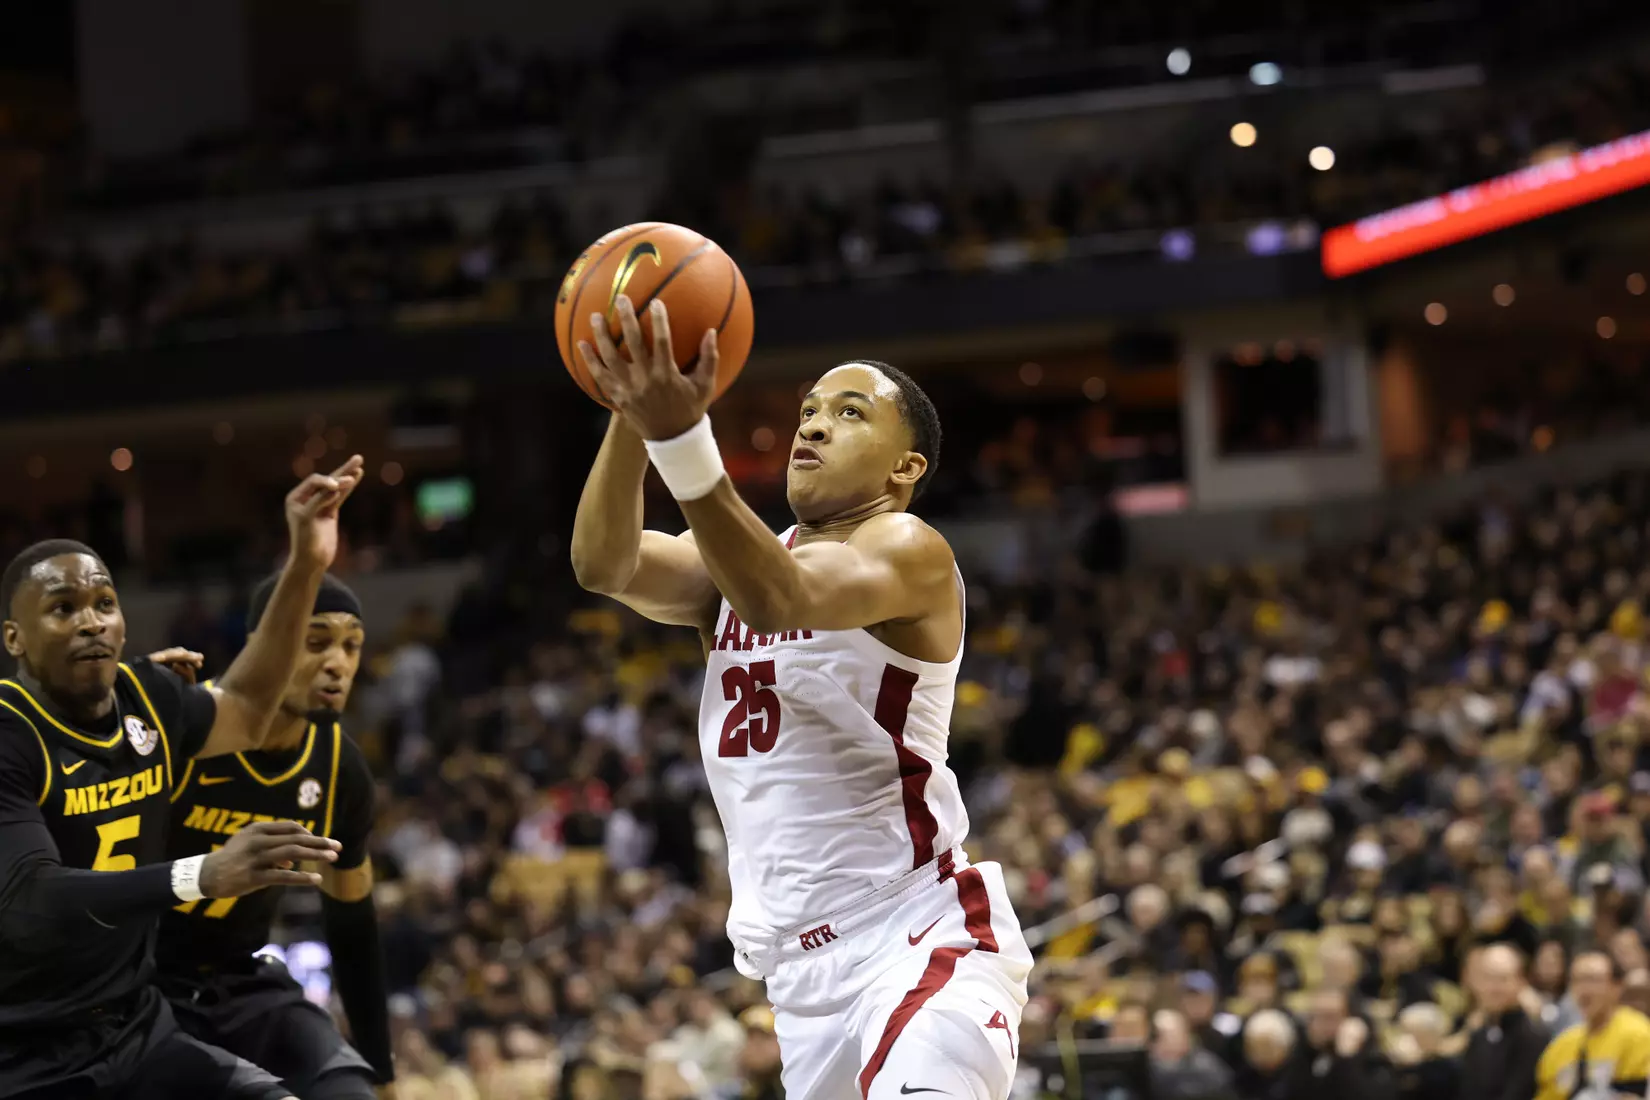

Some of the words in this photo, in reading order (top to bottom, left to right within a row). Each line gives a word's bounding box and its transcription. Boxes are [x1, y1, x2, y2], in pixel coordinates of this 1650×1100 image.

[718, 660, 781, 757] 25
[63, 764, 163, 816] MIZZOU
[91, 814, 141, 872] 5
[183, 805, 316, 835] MIZ
[799, 923, 838, 951] RTR
